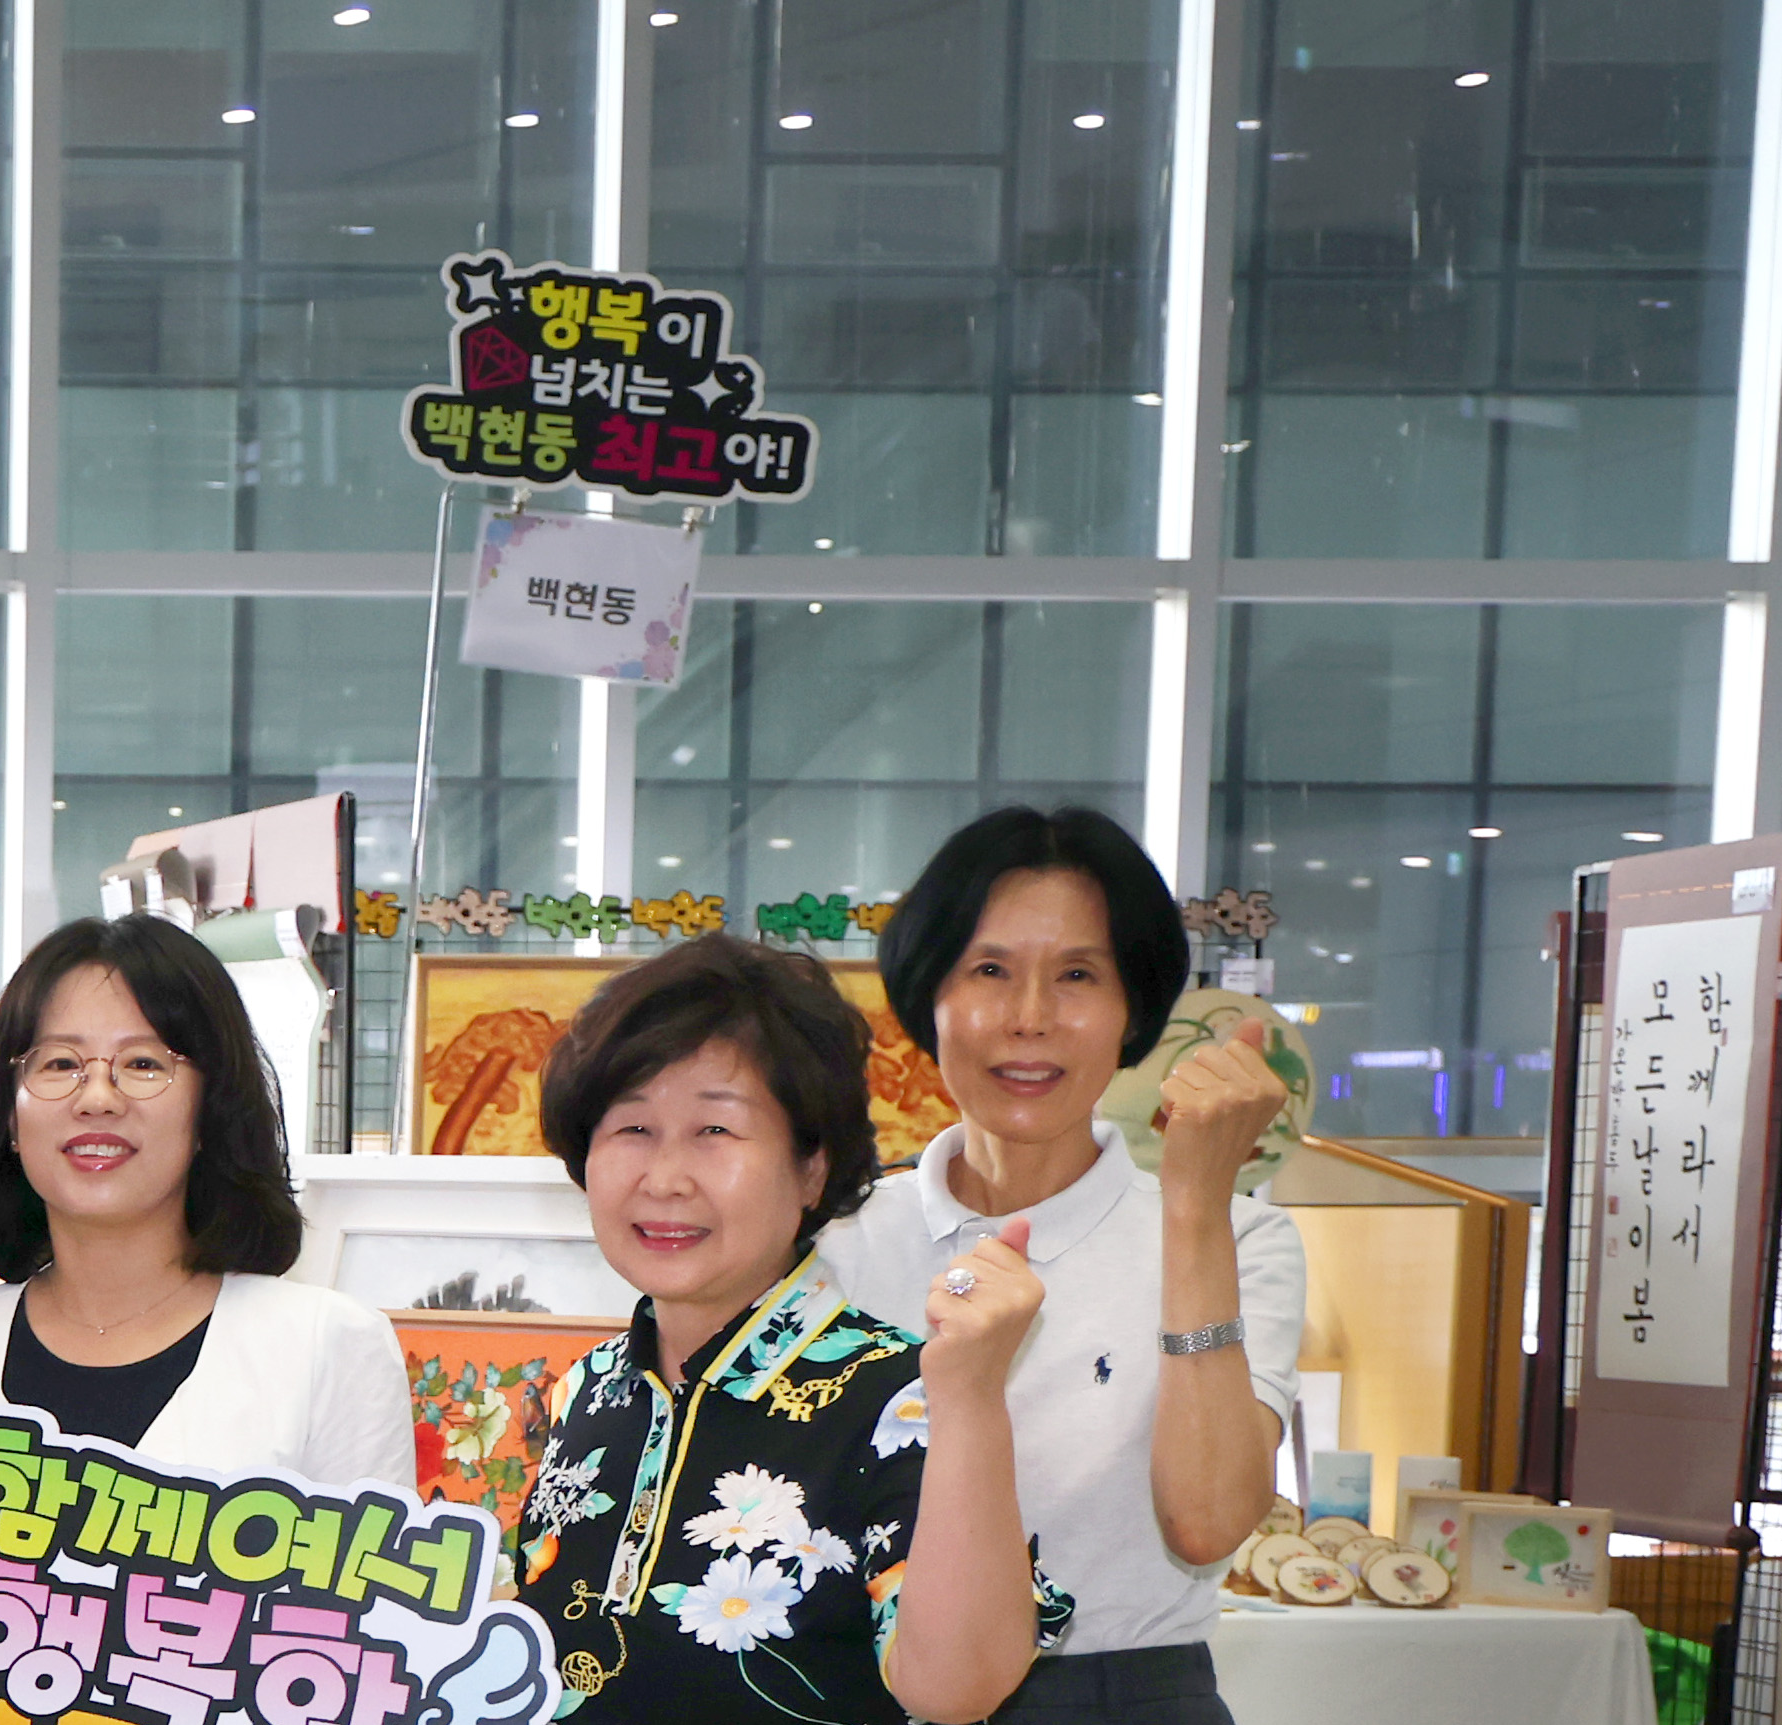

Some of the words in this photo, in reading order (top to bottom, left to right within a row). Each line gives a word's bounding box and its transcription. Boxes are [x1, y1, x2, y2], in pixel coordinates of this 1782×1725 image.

[530, 354, 673, 416] 넘치는
[423, 402, 577, 474] 백현동
[592, 415, 793, 484] 최고야!
[526, 576, 636, 626] 백현동
